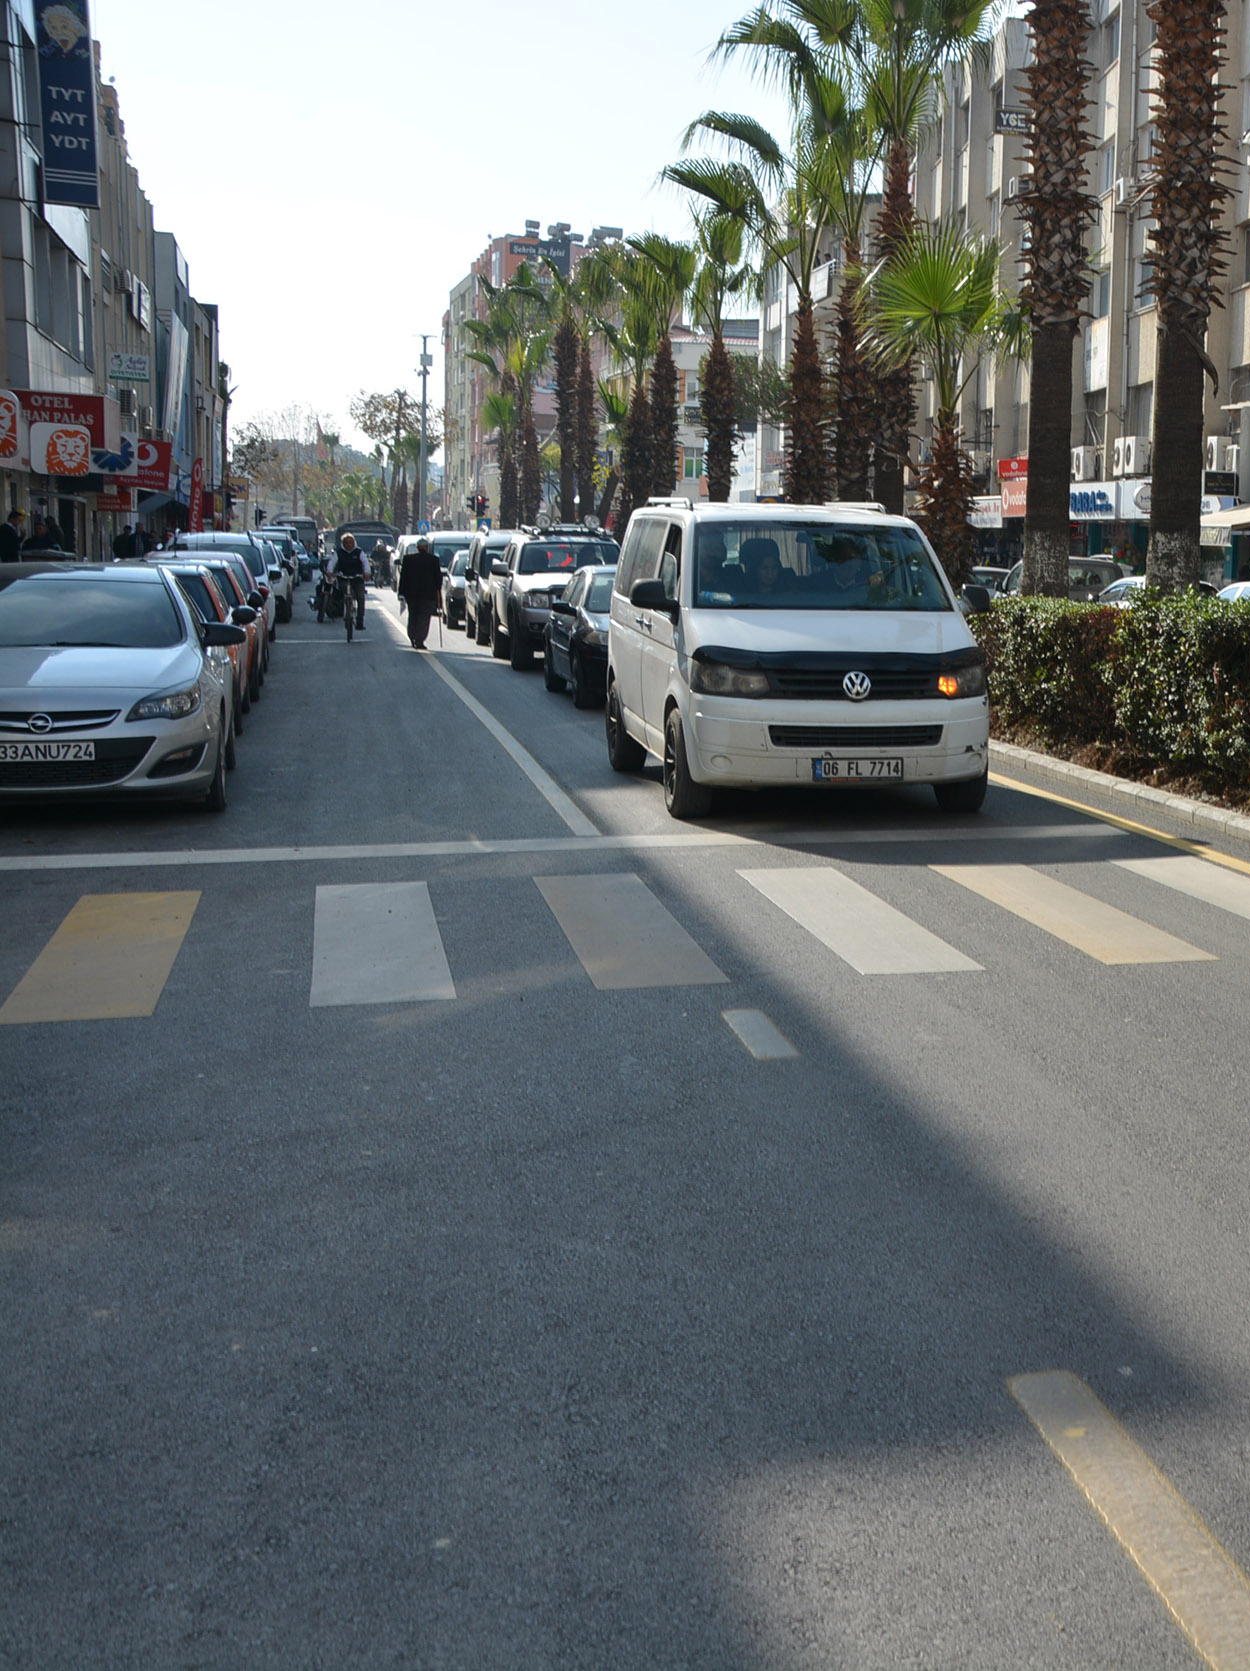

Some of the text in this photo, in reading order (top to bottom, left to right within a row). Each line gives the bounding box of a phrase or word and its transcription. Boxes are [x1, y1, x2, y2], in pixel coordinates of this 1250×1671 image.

[47, 85, 86, 103] TYT
[49, 109, 88, 127] AYT
[50, 133, 90, 151] YDT
[30, 394, 73, 409] OTEL
[22, 408, 94, 425] HAN PALAS
[1071, 491, 1096, 512] BABA
[823, 761, 900, 776] 06 FL 7714
